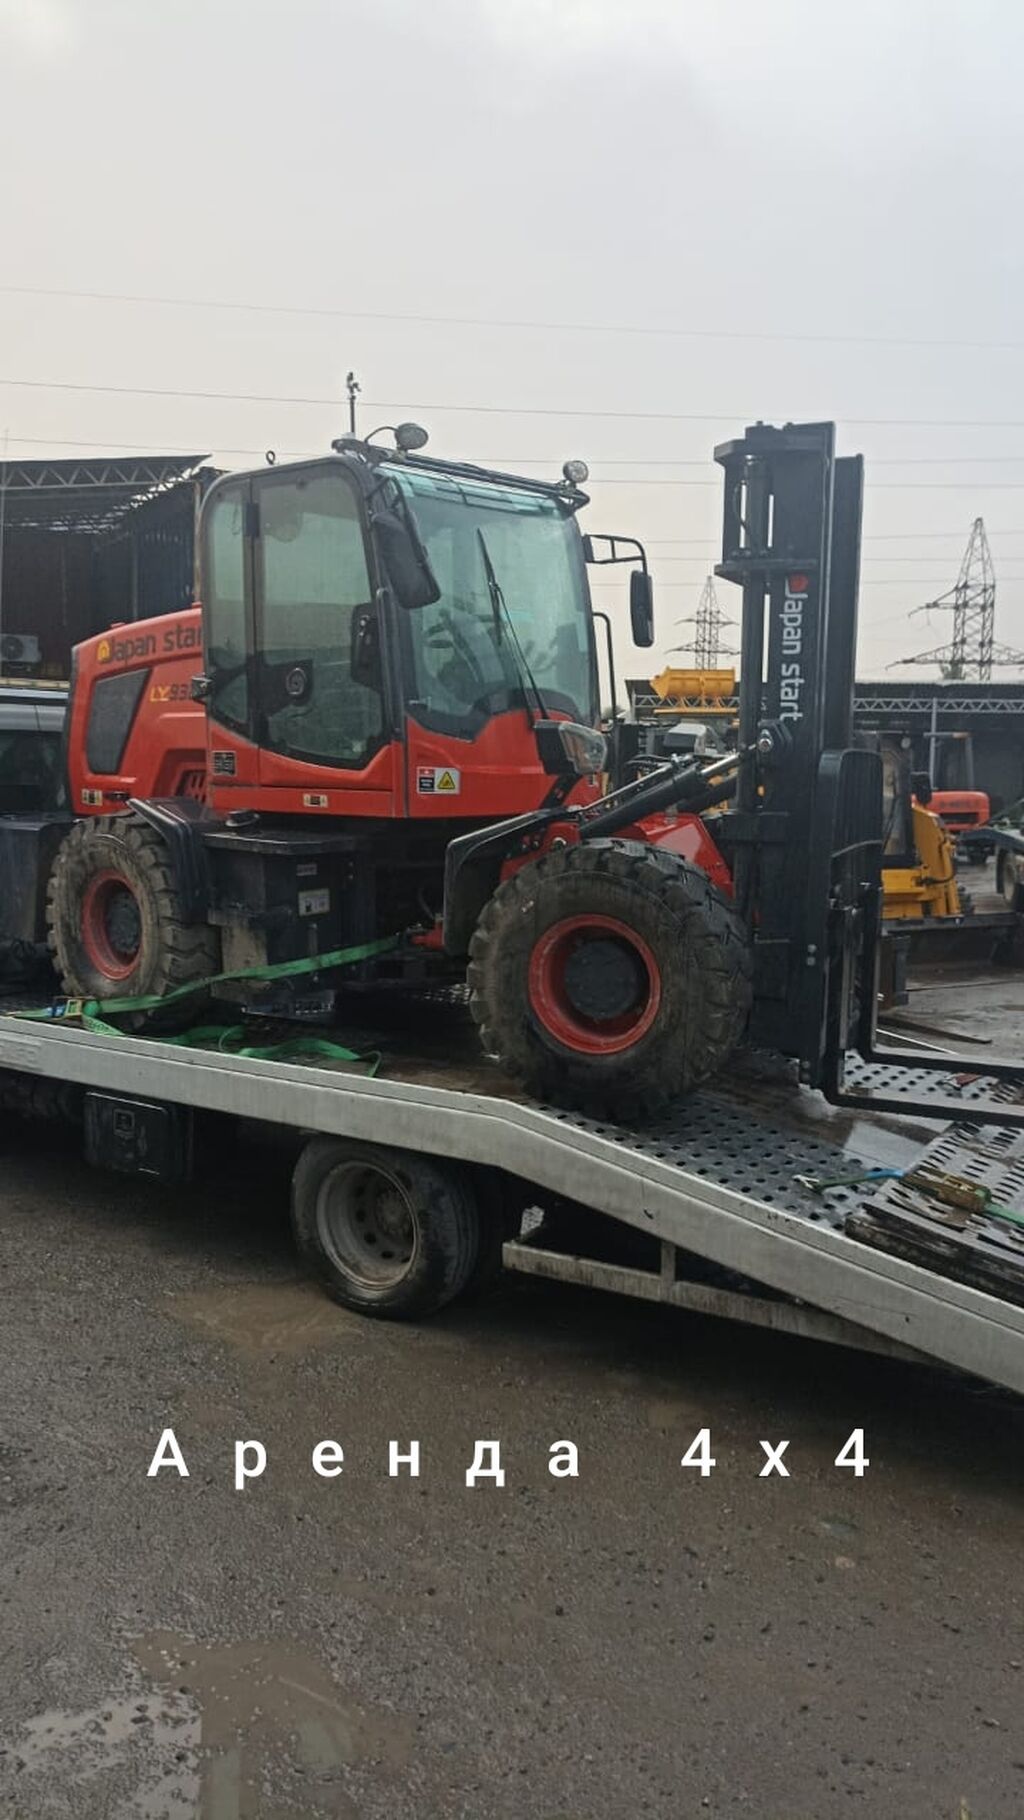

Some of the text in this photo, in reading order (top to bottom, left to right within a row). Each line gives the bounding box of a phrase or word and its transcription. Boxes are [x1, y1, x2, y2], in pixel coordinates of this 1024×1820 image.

[98, 633, 156, 666] Japan
[779, 577, 808, 721] Japan start
